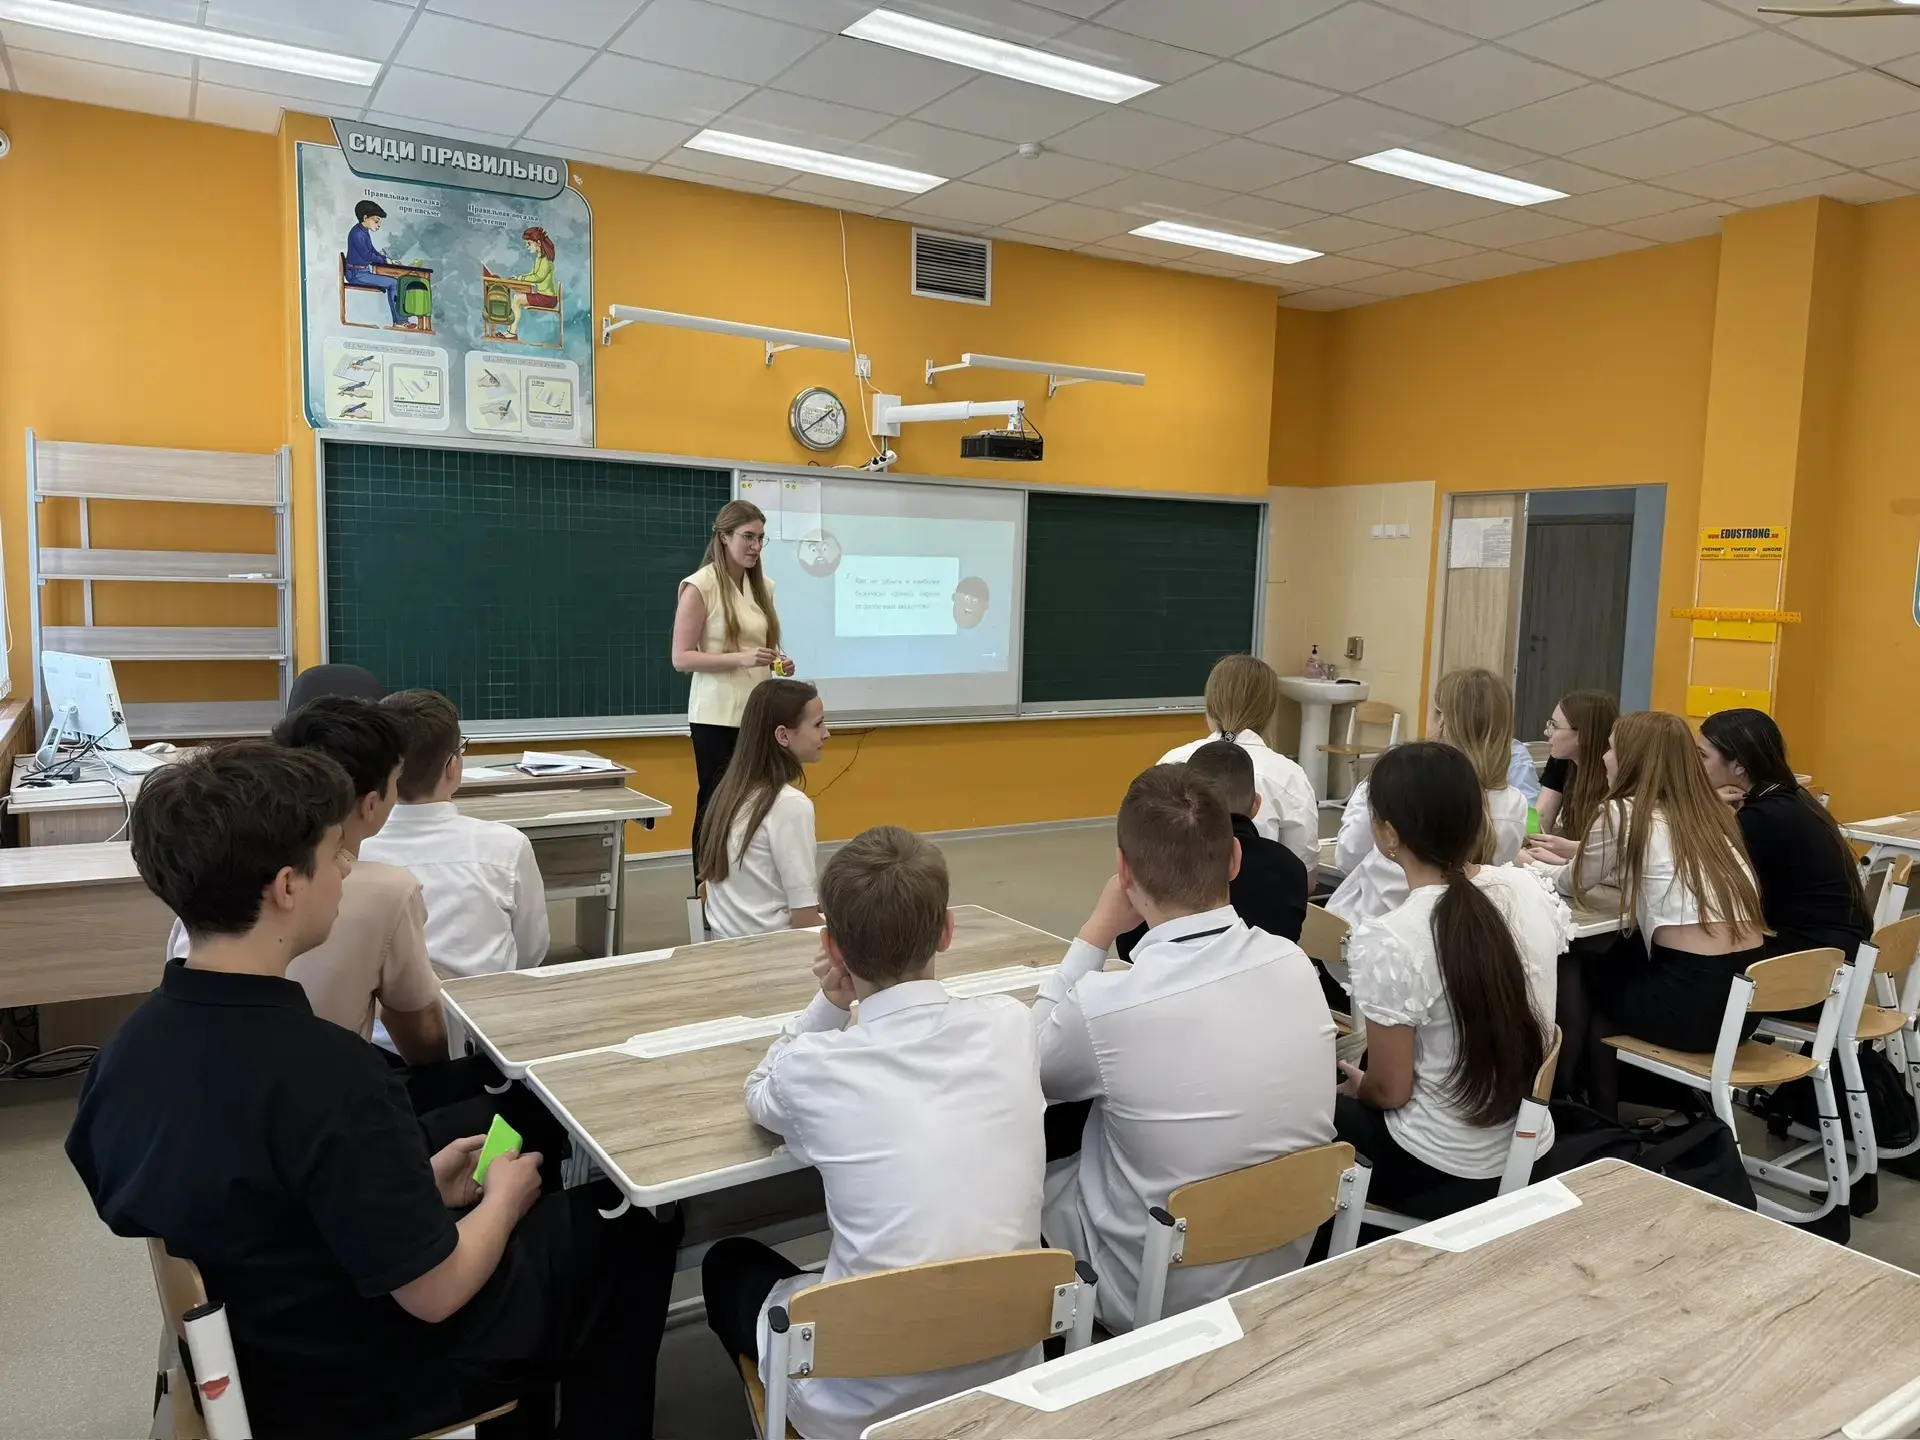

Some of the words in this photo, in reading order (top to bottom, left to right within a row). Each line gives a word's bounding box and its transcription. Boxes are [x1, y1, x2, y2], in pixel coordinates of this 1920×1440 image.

[348, 132, 416, 162] СИДИ
[421, 144, 559, 185] ПРАВИЛЬНО
[364, 188, 410, 202] Правильная
[411, 196, 441, 206] посадка
[398, 205, 413, 215] при
[414, 208, 441, 217] письме
[468, 204, 510, 218] Правильная
[511, 212, 540, 222] посадка
[1721, 528, 1770, 539] EDUSTRONG
